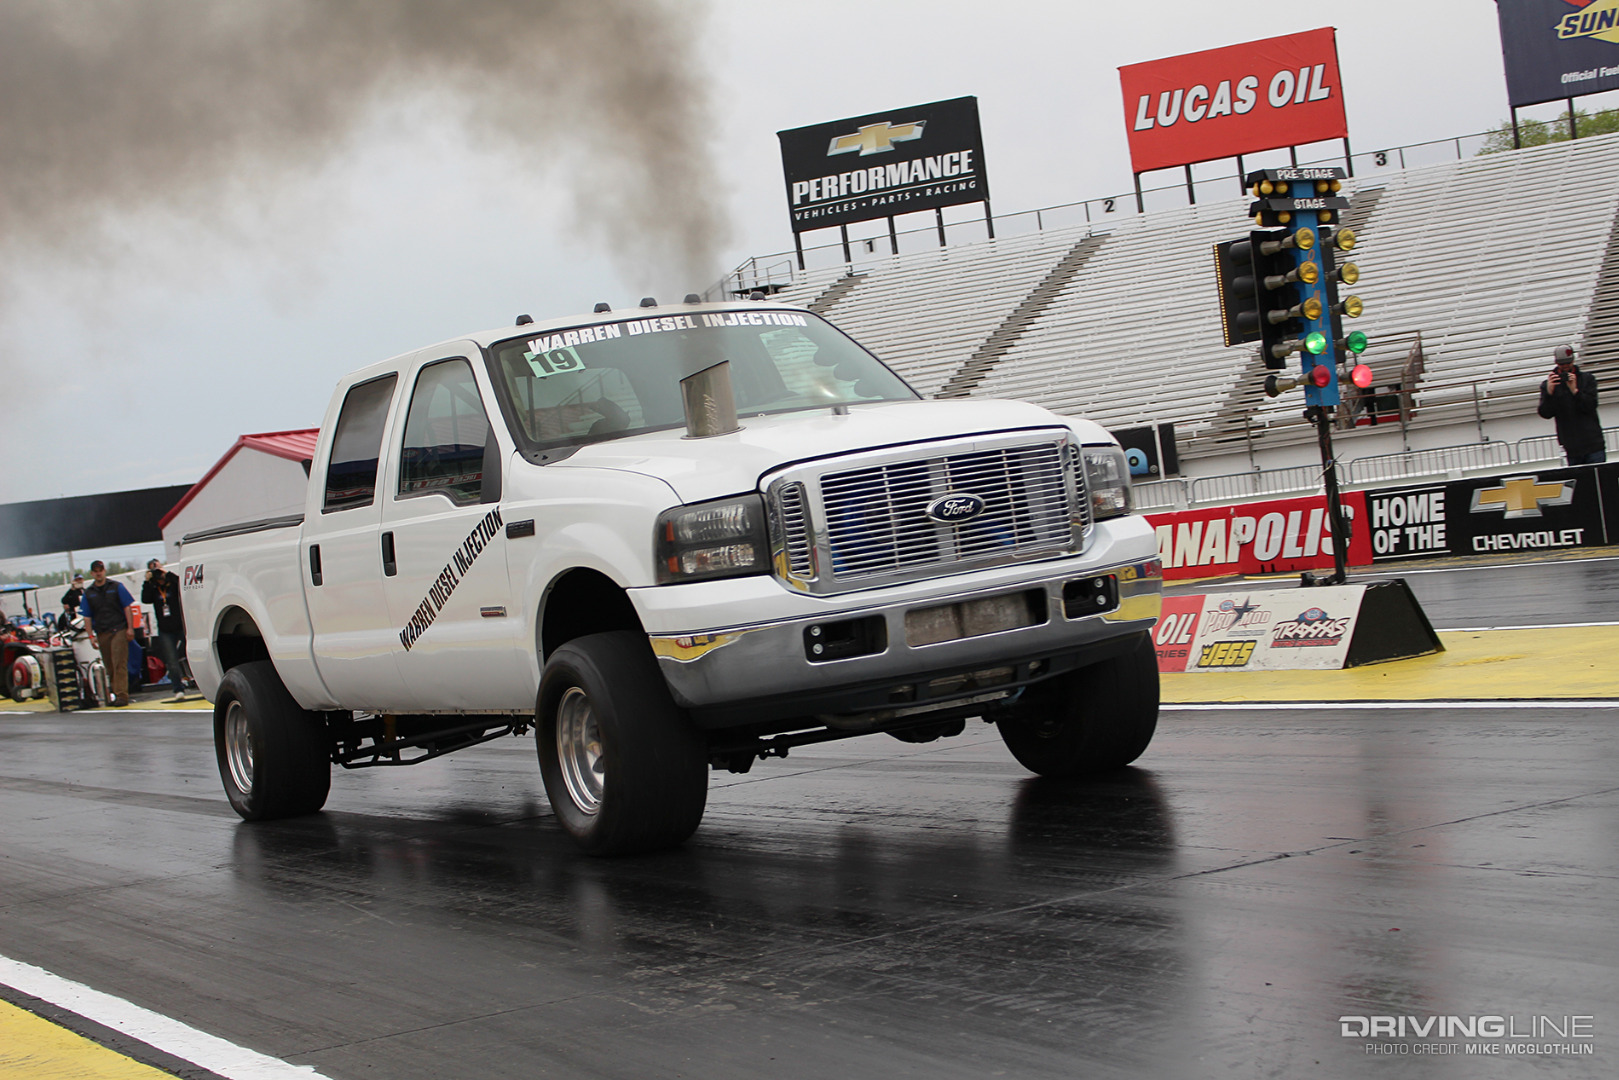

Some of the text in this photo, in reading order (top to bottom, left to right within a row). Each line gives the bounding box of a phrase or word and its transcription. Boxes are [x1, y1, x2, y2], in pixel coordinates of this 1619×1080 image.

[1562, 8, 1619, 36] SUN
[1561, 68, 1598, 84] Official
[1133, 63, 1332, 132] LUCAS OIL
[1375, 152, 1387, 166] 3
[792, 149, 974, 206] PERFORMANCE
[1276, 168, 1336, 180] PRE-STAGE
[794, 180, 977, 221] VEHICLES PARTS RACING
[1104, 199, 1115, 213] 2
[1293, 198, 1327, 210] STAGE
[865, 239, 875, 253] 1
[527, 312, 808, 356] WARREN DIESEL INJECTION
[530, 348, 579, 374] 19
[942, 498, 975, 516] Ford
[1372, 492, 1446, 529] HOME
[1373, 524, 1447, 554] OF THE
[1472, 528, 1585, 552] CHEVROLET
[183, 563, 204, 587] FX4
[398, 596, 437, 652] WARREN
[428, 563, 460, 612] DIESEL
[452, 505, 504, 578] INJECTION
[1155, 612, 1198, 647] OIL
[1272, 617, 1351, 640] TRAXXAS
[1197, 640, 1257, 668] JEGS
